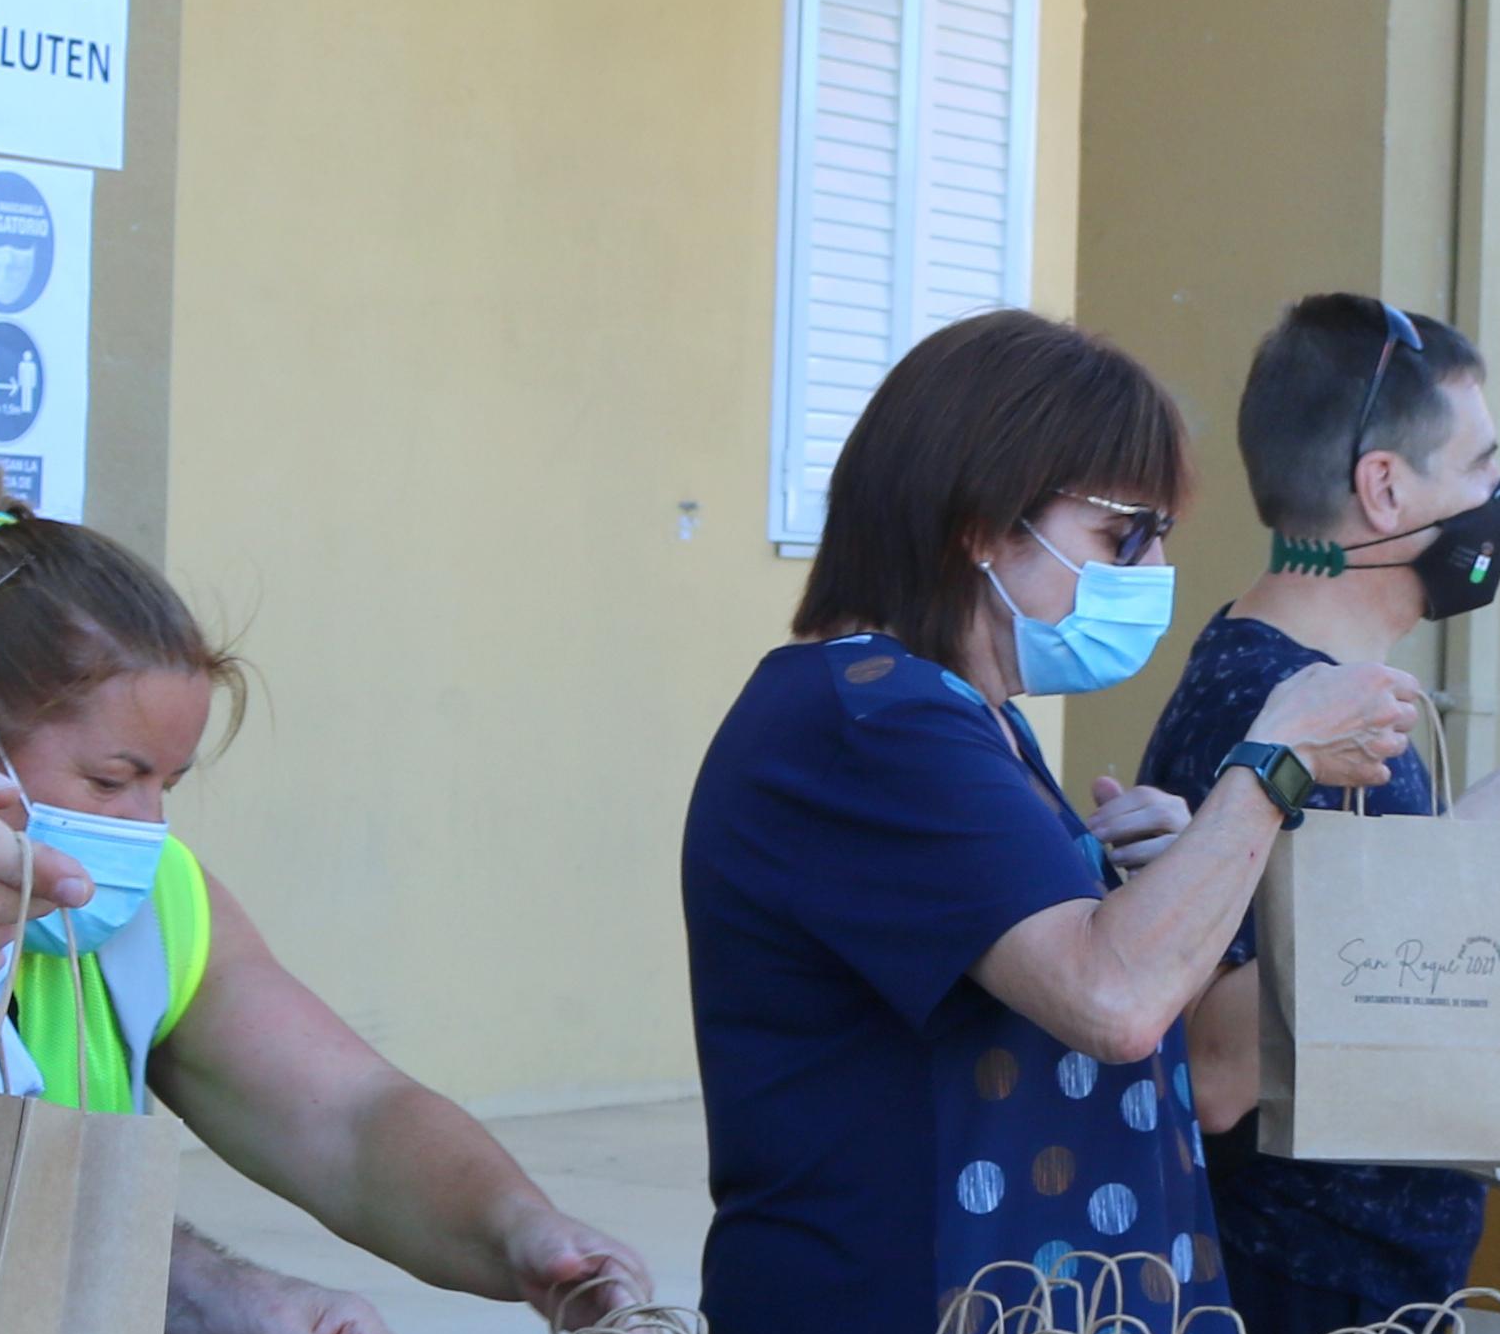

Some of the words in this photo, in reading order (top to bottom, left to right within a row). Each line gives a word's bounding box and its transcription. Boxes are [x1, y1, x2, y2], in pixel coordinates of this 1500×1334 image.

[1338, 938, 1388, 987] San
[1396, 939, 1460, 995] Roque
[1465, 956, 1496, 975] 2021
